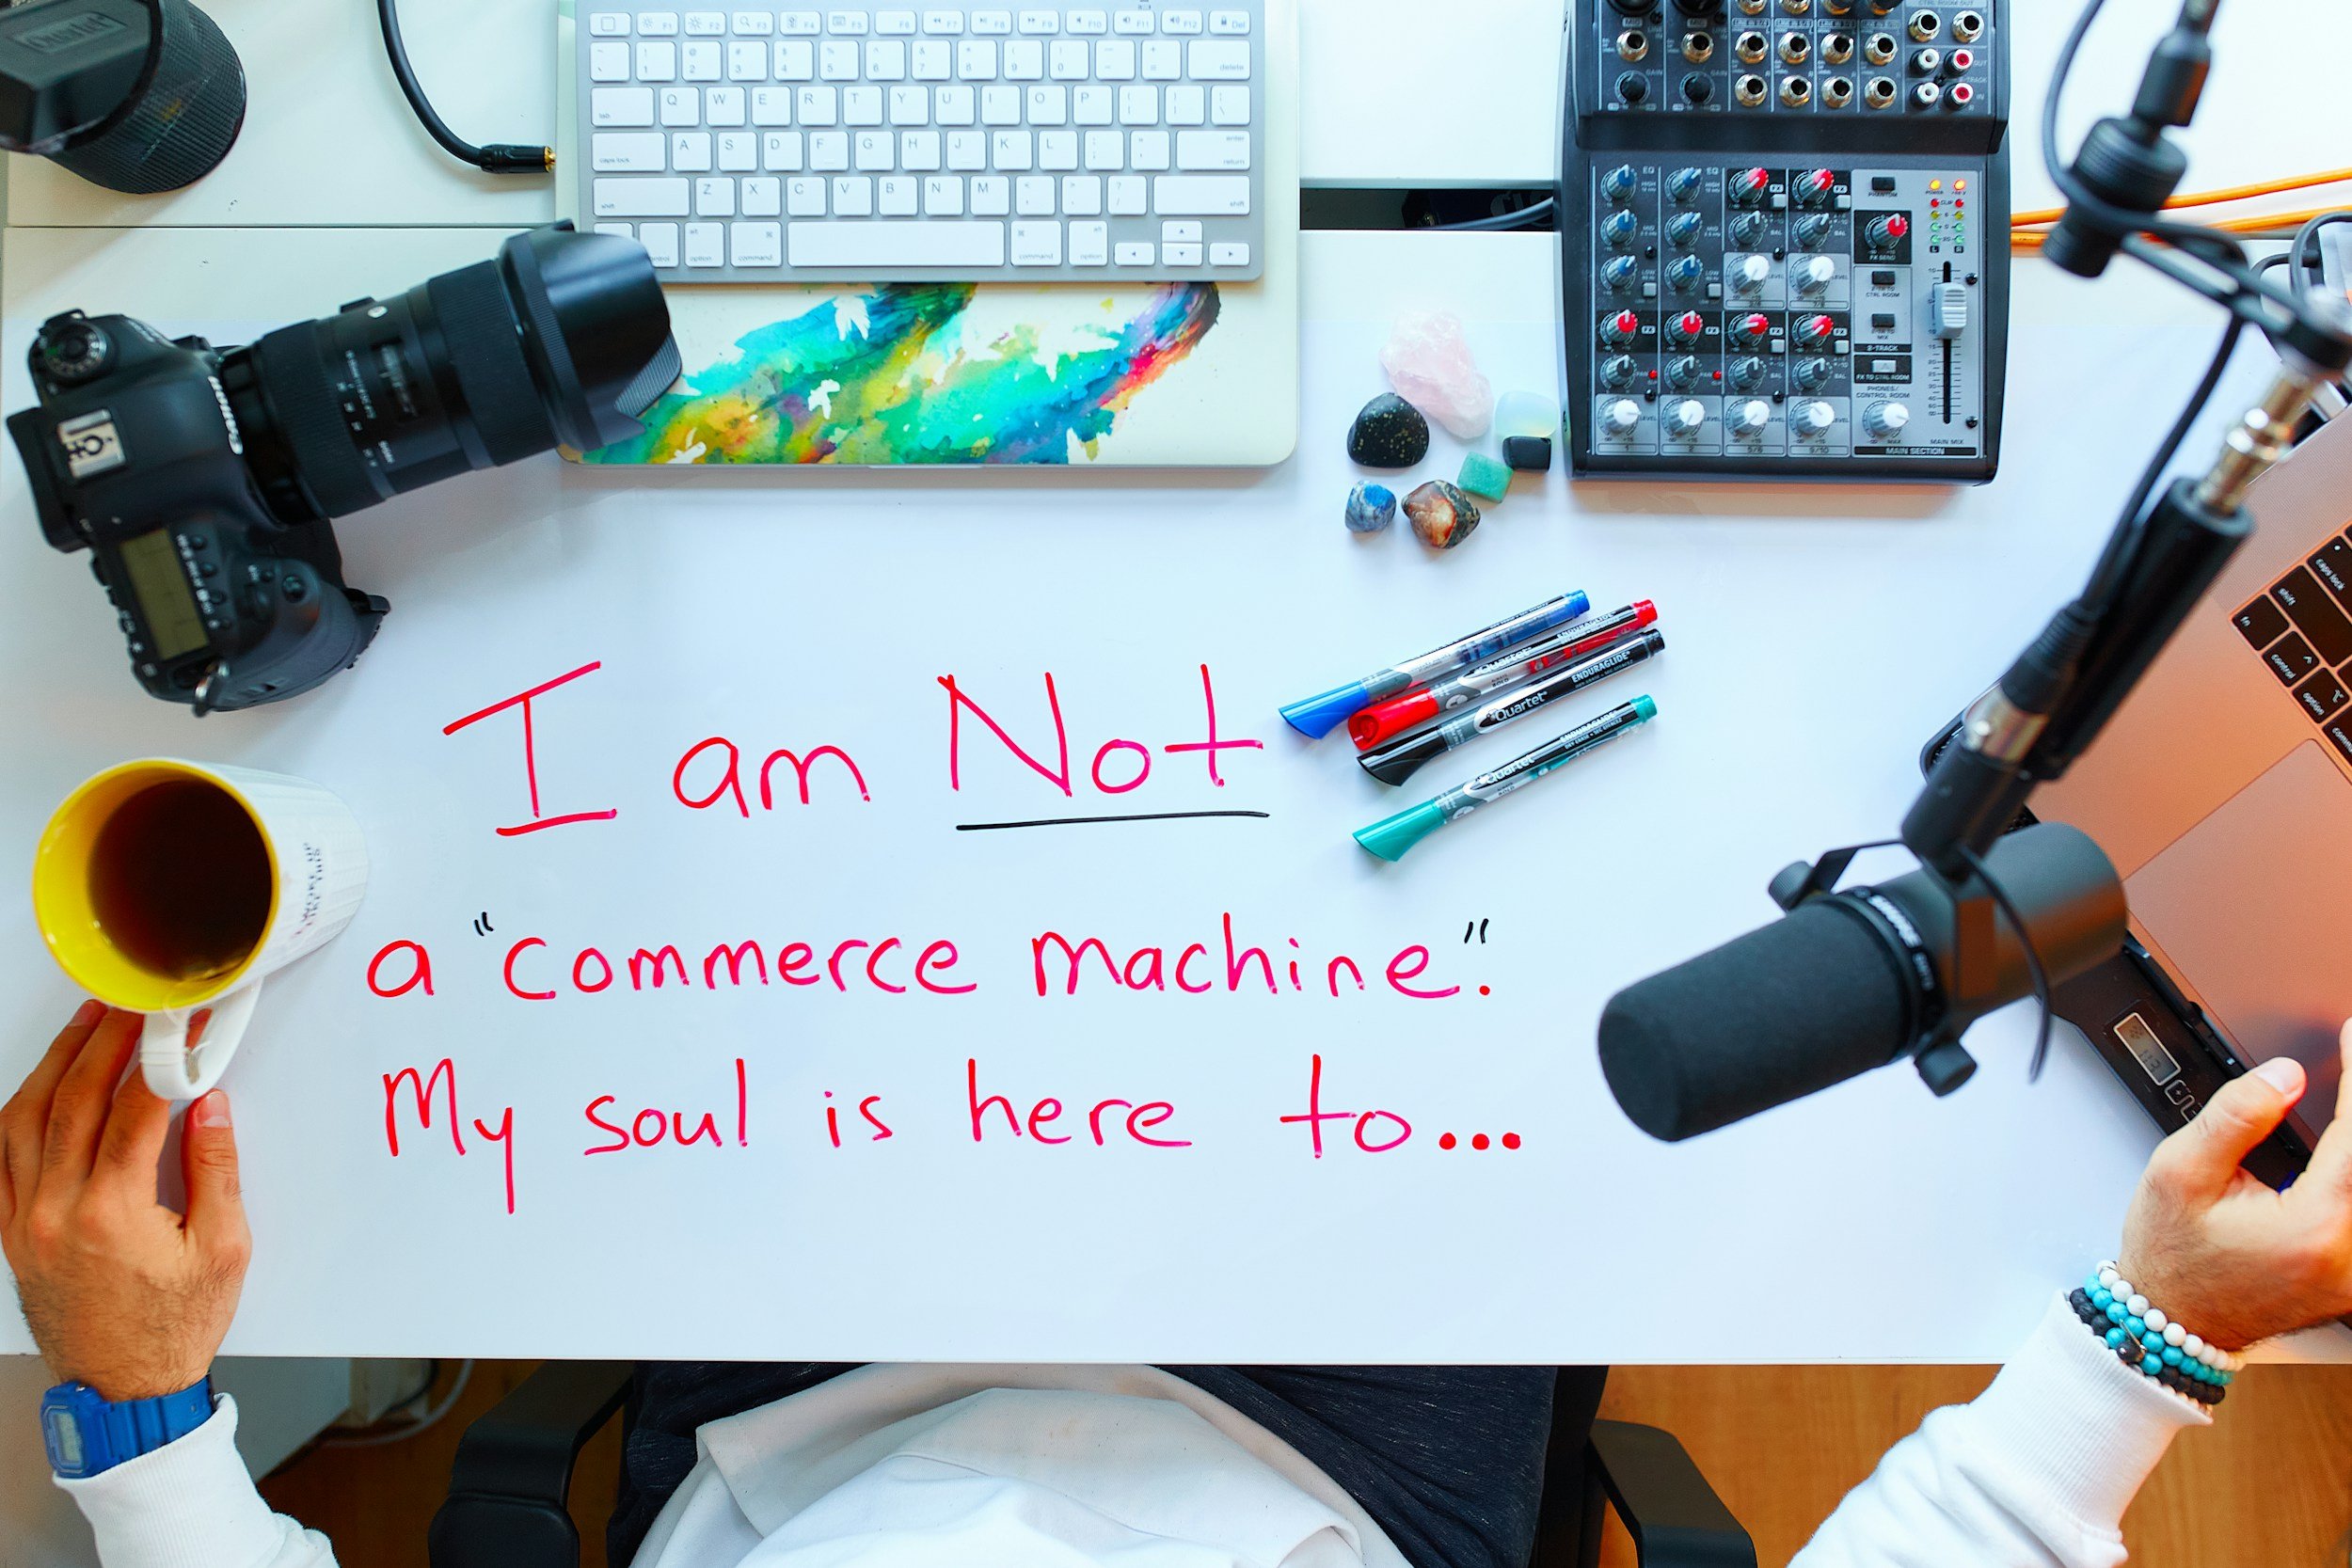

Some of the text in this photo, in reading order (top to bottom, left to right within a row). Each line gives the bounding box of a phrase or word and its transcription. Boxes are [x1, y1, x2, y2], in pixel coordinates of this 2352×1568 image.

[666, 93, 677, 106] Q
[713, 93, 726, 104] W
[758, 93, 766, 104] E
[804, 93, 814, 104] R
[850, 93, 859, 104] T
[897, 93, 906, 103] Y
[943, 92, 951, 103] U
[1035, 92, 1045, 103] O
[1081, 92, 1089, 103] P
[679, 139, 689, 150] A
[725, 139, 733, 150] S
[771, 138, 780, 150] D
[817, 138, 824, 150] F
[863, 138, 873, 150] G
[909, 138, 917, 150] H
[955, 138, 961, 150] J
[1000, 138, 1009, 150] K
[1046, 138, 1053, 150] L
[703, 184, 711, 195] Z
[749, 184, 757, 195] X
[794, 183, 803, 195] C
[840, 183, 850, 194] V
[886, 183, 894, 194] B
[931, 182, 941, 193] N
[977, 182, 989, 193] M
[2314, 558, 2346, 591] caps lock
[2277, 587, 2296, 607] shift
[2240, 615, 2251, 627] fn
[1478, 647, 1531, 674] Quartet
[2270, 653, 2296, 680] control
[1571, 652, 1629, 683] ENDURAGLIDE
[1494, 691, 1543, 722] Quartet
[2302, 692, 2325, 716] option
[443, 660, 1265, 837] I am Not
[1486, 755, 1535, 785] Quartet
[366, 939, 435, 999] a
[383, 1057, 516, 1214] My
[583, 1057, 749, 1157] soul
[824, 1090, 894, 1148] is
[967, 1057, 1193, 1148] here
